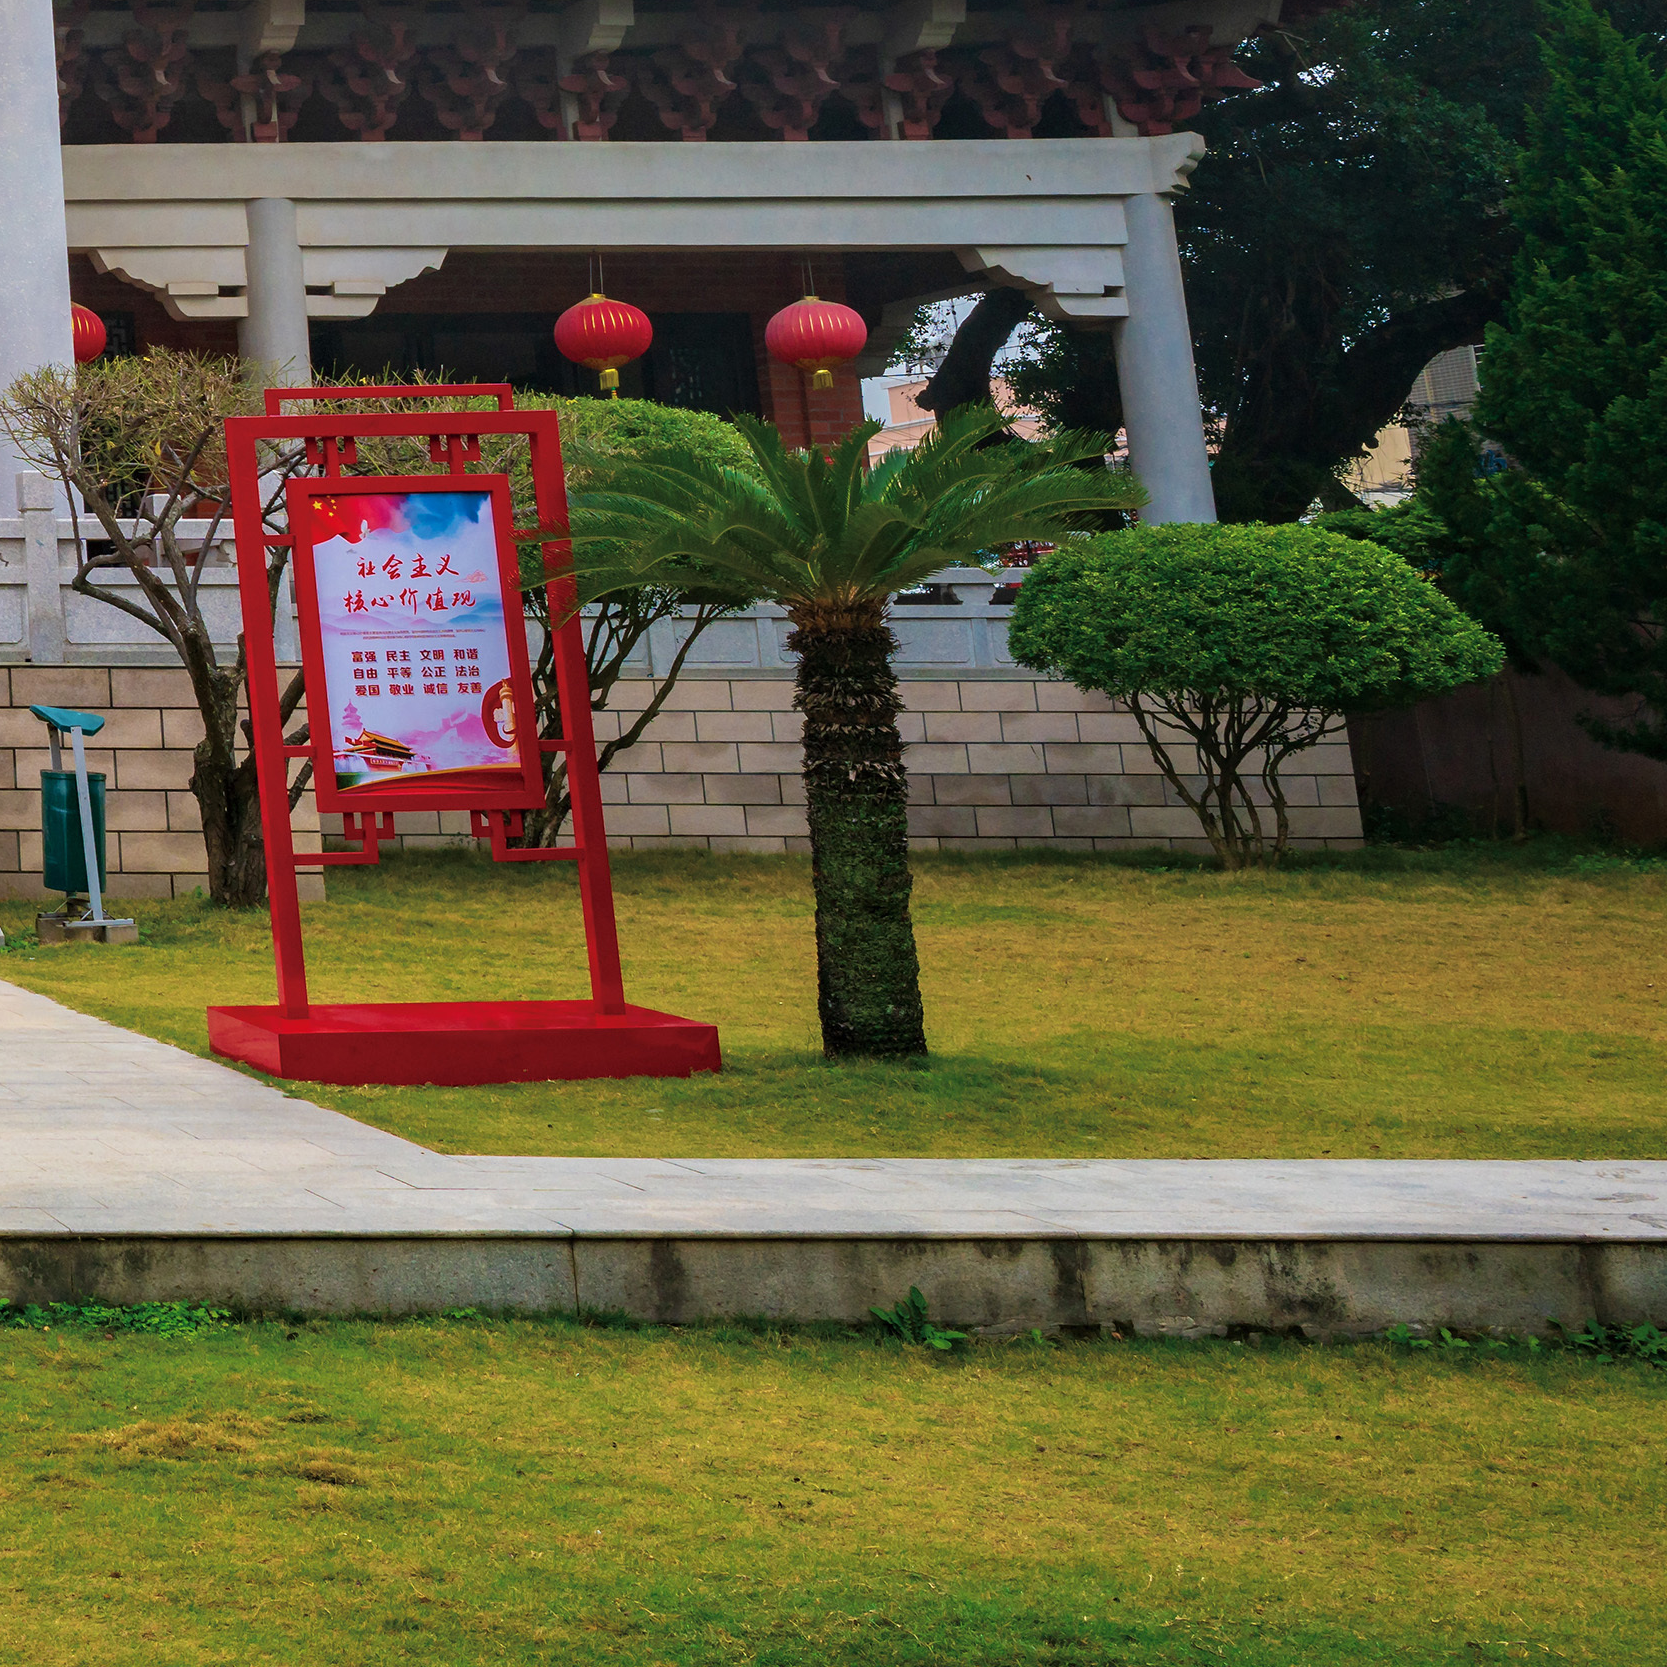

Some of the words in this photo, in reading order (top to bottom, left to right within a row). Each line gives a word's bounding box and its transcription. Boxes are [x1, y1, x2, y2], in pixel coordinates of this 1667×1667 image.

[356, 553, 459, 580] 社会主义
[351, 650, 377, 663] 富强
[386, 649, 410, 662] 民主
[419, 649, 444, 661] 文明
[453, 648, 479, 660] 和谐
[353, 667, 378, 679] 自由
[387, 667, 412, 679] 平等
[421, 666, 446, 678] 公正
[455, 665, 480, 677] 法治
[355, 684, 380, 696] 爱国
[389, 683, 414, 696] 敬业
[423, 682, 448, 695] 诚信
[457, 682, 482, 694] 友善
